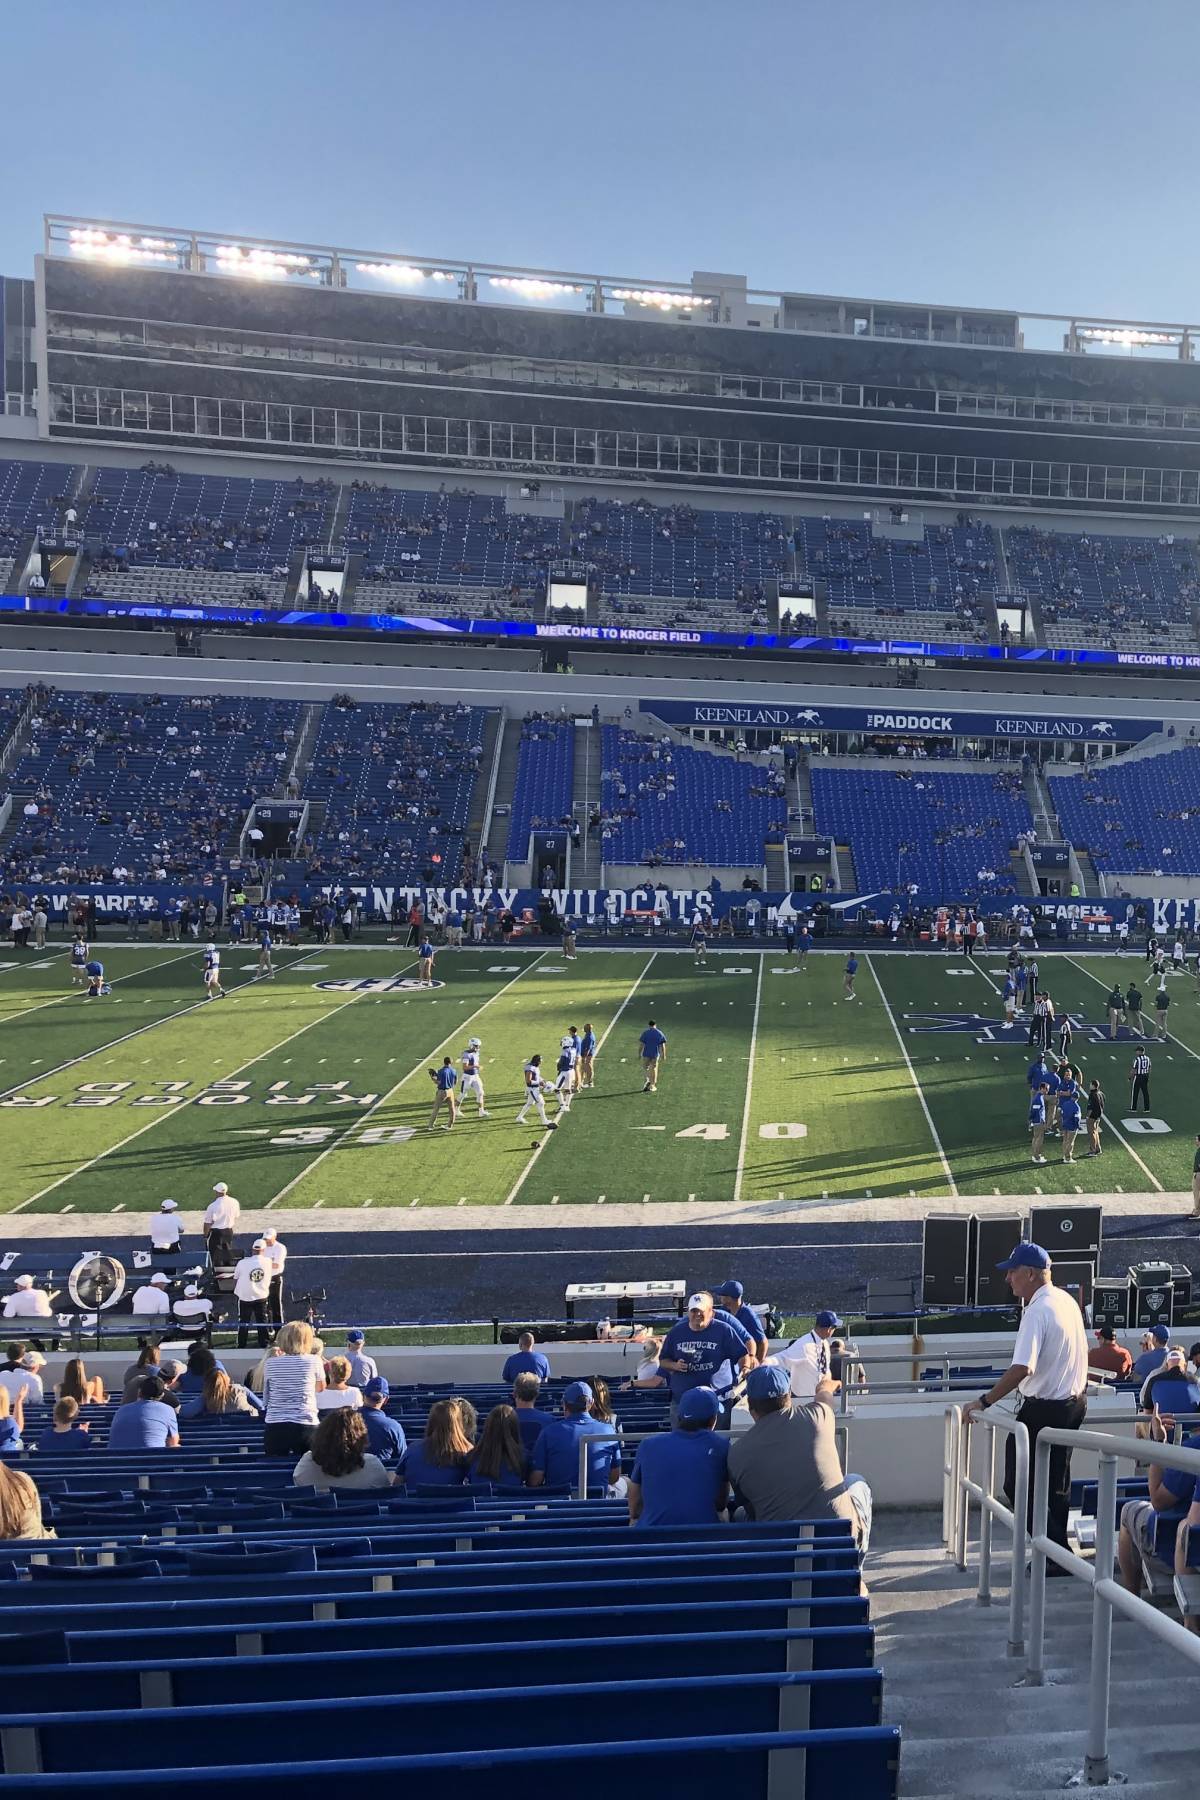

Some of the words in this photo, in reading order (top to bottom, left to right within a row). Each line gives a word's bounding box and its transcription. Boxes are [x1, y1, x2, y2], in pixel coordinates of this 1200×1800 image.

[536, 624, 599, 638] WELCOME
[601, 628, 618, 639] TO
[620, 629, 668, 642] KROGER
[670, 632, 701, 643] FIELD
[1117, 653, 1168, 666] WELCOME
[1170, 656, 1183, 667] TO
[695, 707, 789, 724] KEENELAND
[874, 714, 953, 731] PADDOCK
[995, 719, 1083, 736] KEENELAND
[262, 810, 272, 818] 29
[546, 841, 555, 849] 27
[817, 848, 825, 856] 26
[1033, 852, 1042, 860] 26
[1056, 853, 1064, 861] 25
[674, 1122, 808, 1140] 40
[1102, 1292, 1119, 1311] E
[676, 1341, 718, 1351] KENTUCKY
